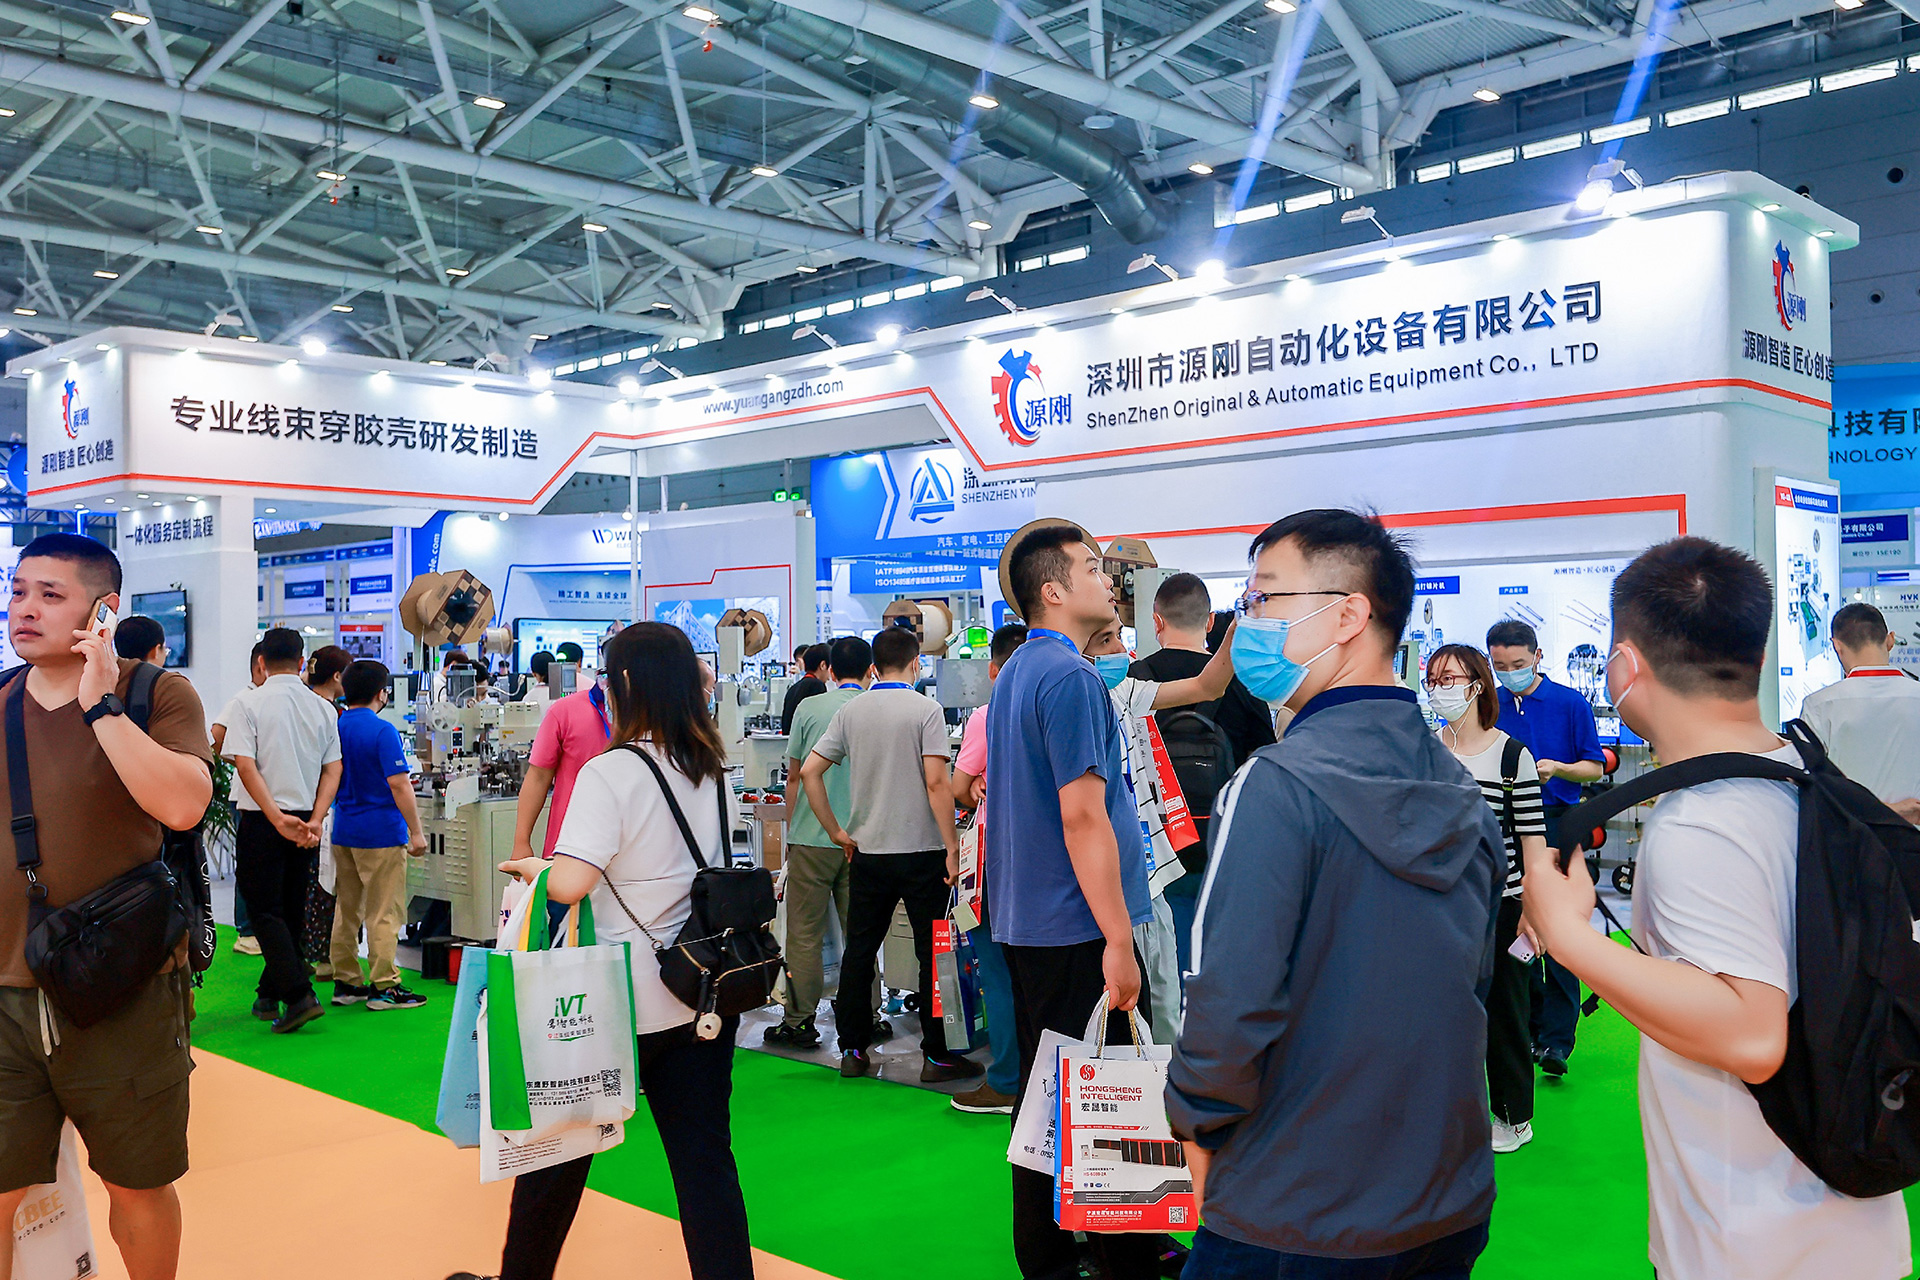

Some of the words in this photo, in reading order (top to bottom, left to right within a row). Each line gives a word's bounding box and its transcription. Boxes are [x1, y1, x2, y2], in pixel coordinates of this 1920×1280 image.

[1086, 280, 1602, 398] 深圳市源刚自动化设备有限公司
[1743, 329, 1791, 371] 源刚智造
[1793, 346, 1835, 383] 匠心创造
[703, 379, 844, 414] www.yuangangzdh.com
[1086, 404, 1170, 430] ShenZhen
[1173, 393, 1243, 420] Original
[1247, 389, 1260, 406] &
[1266, 374, 1364, 405] Automatic
[1369, 357, 1485, 394] Equipment
[1550, 341, 1599, 368] LTD
[1024, 393, 1072, 428] 源刚
[1829, 408, 1920, 438] 技有
[170, 394, 539, 461] 专业线束穿胶壳研发制造
[41, 449, 76, 474] 源刚智造
[77, 439, 114, 466] 匠心创造
[961, 489, 1018, 504] SHENZHEN
[125, 515, 214, 546] 一体化服务定制流程
[937, 532, 1014, 549] 汽车、家电、工控自
[1841, 522, 1885, 534] 子有限公司
[1080, 1085, 1143, 1094] HONGSHENG
[1080, 1092, 1143, 1102] INTELLIGENT
